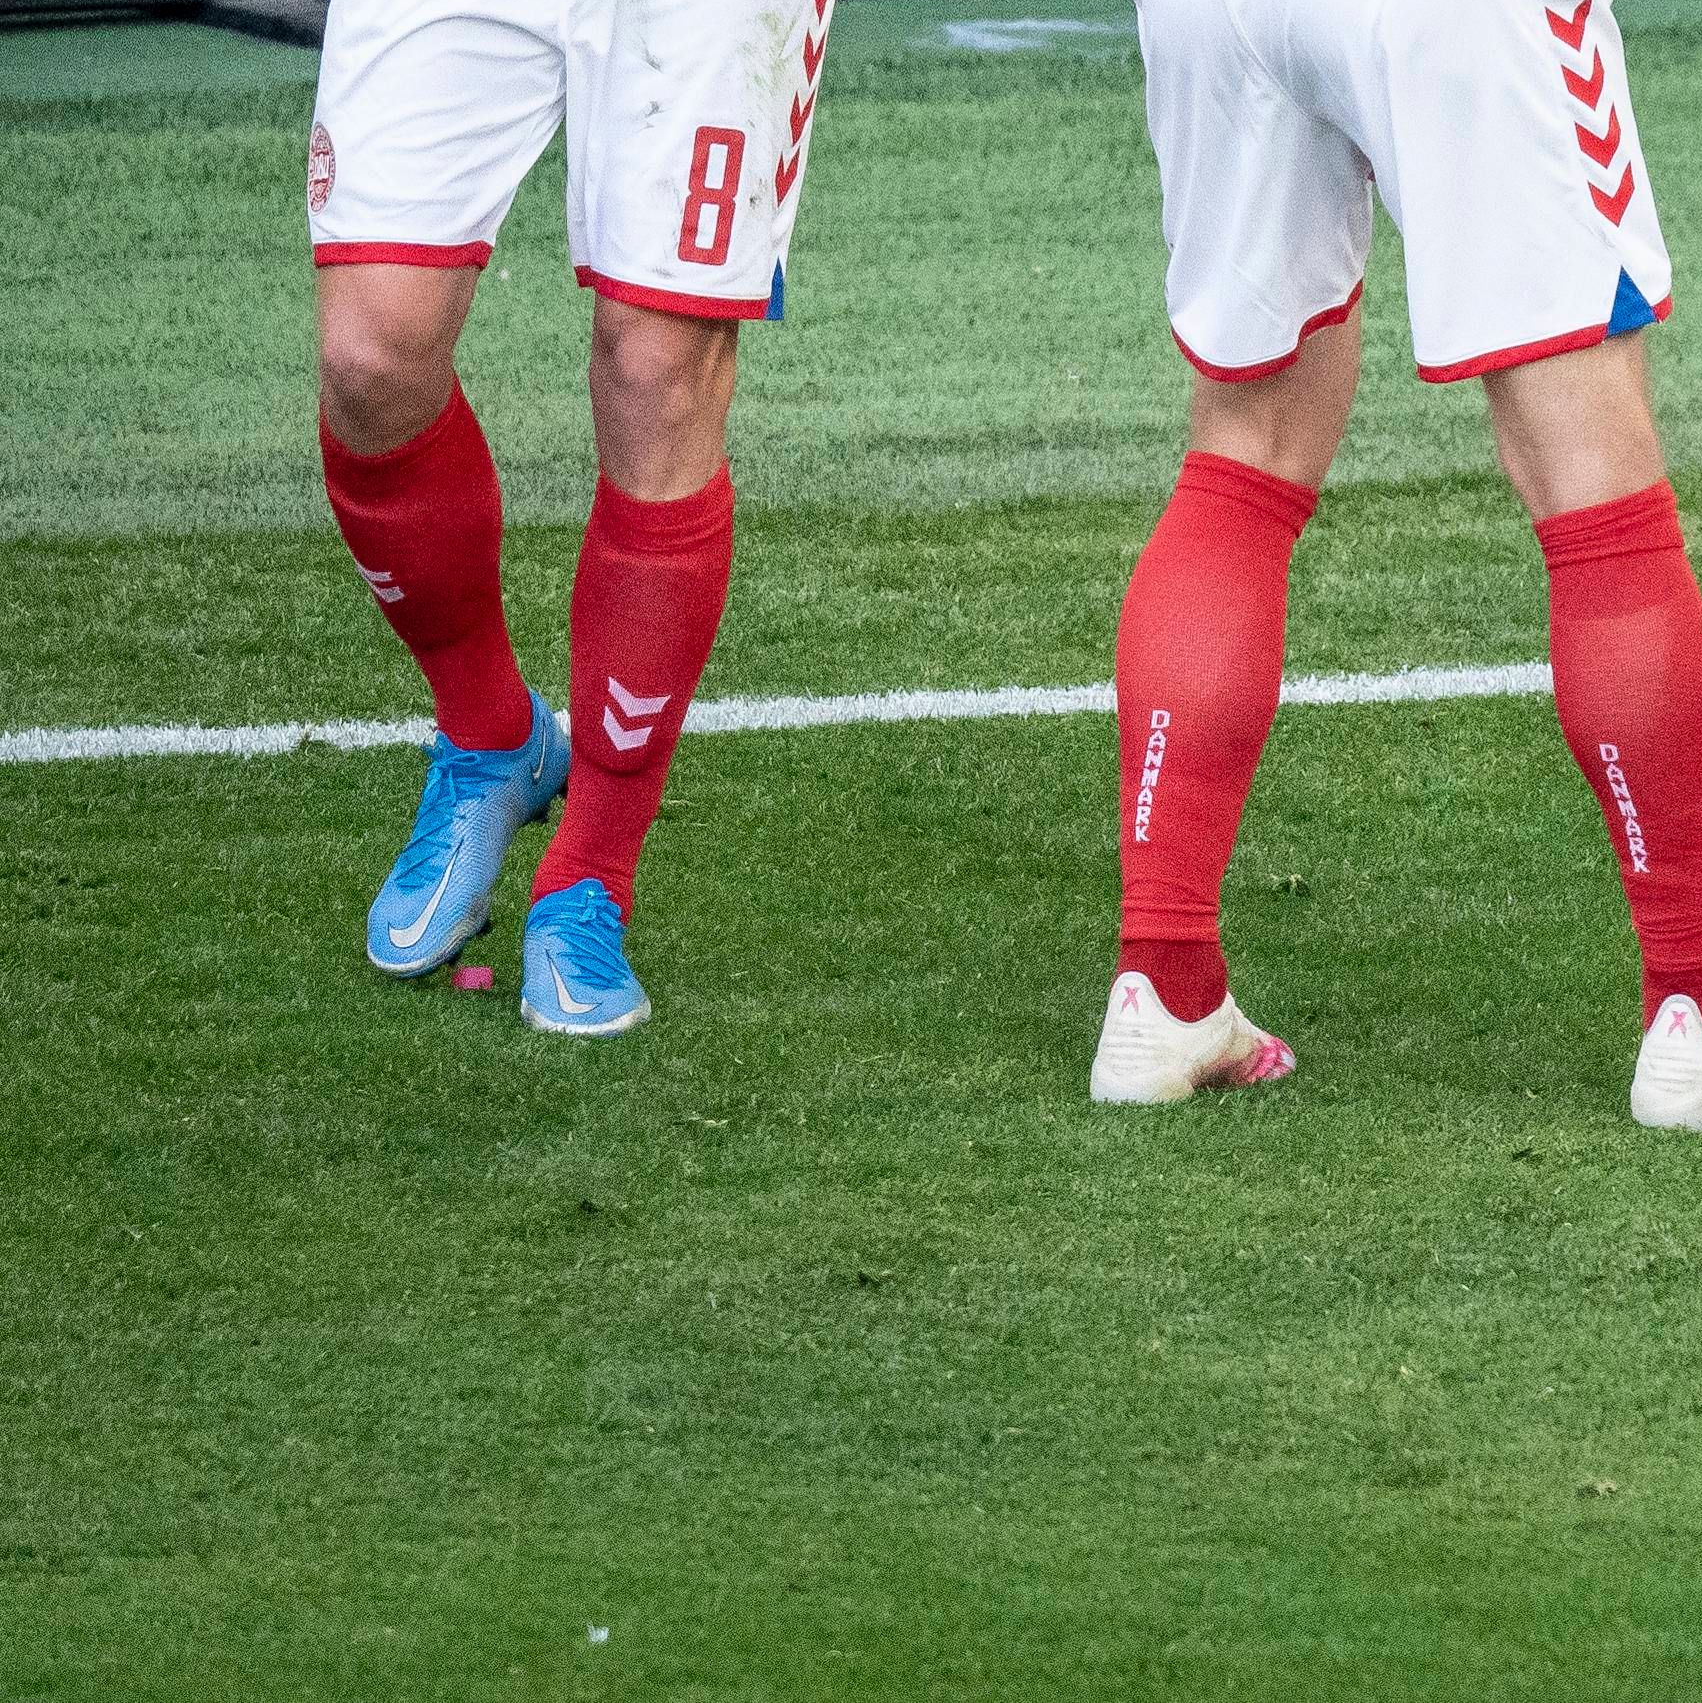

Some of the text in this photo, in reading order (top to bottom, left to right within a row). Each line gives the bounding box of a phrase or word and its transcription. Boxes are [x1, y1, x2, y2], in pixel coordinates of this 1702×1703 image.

[677, 125, 746, 266] 8
[1134, 709, 1171, 843] DANMARK
[1599, 743, 1652, 874] DANMARK
